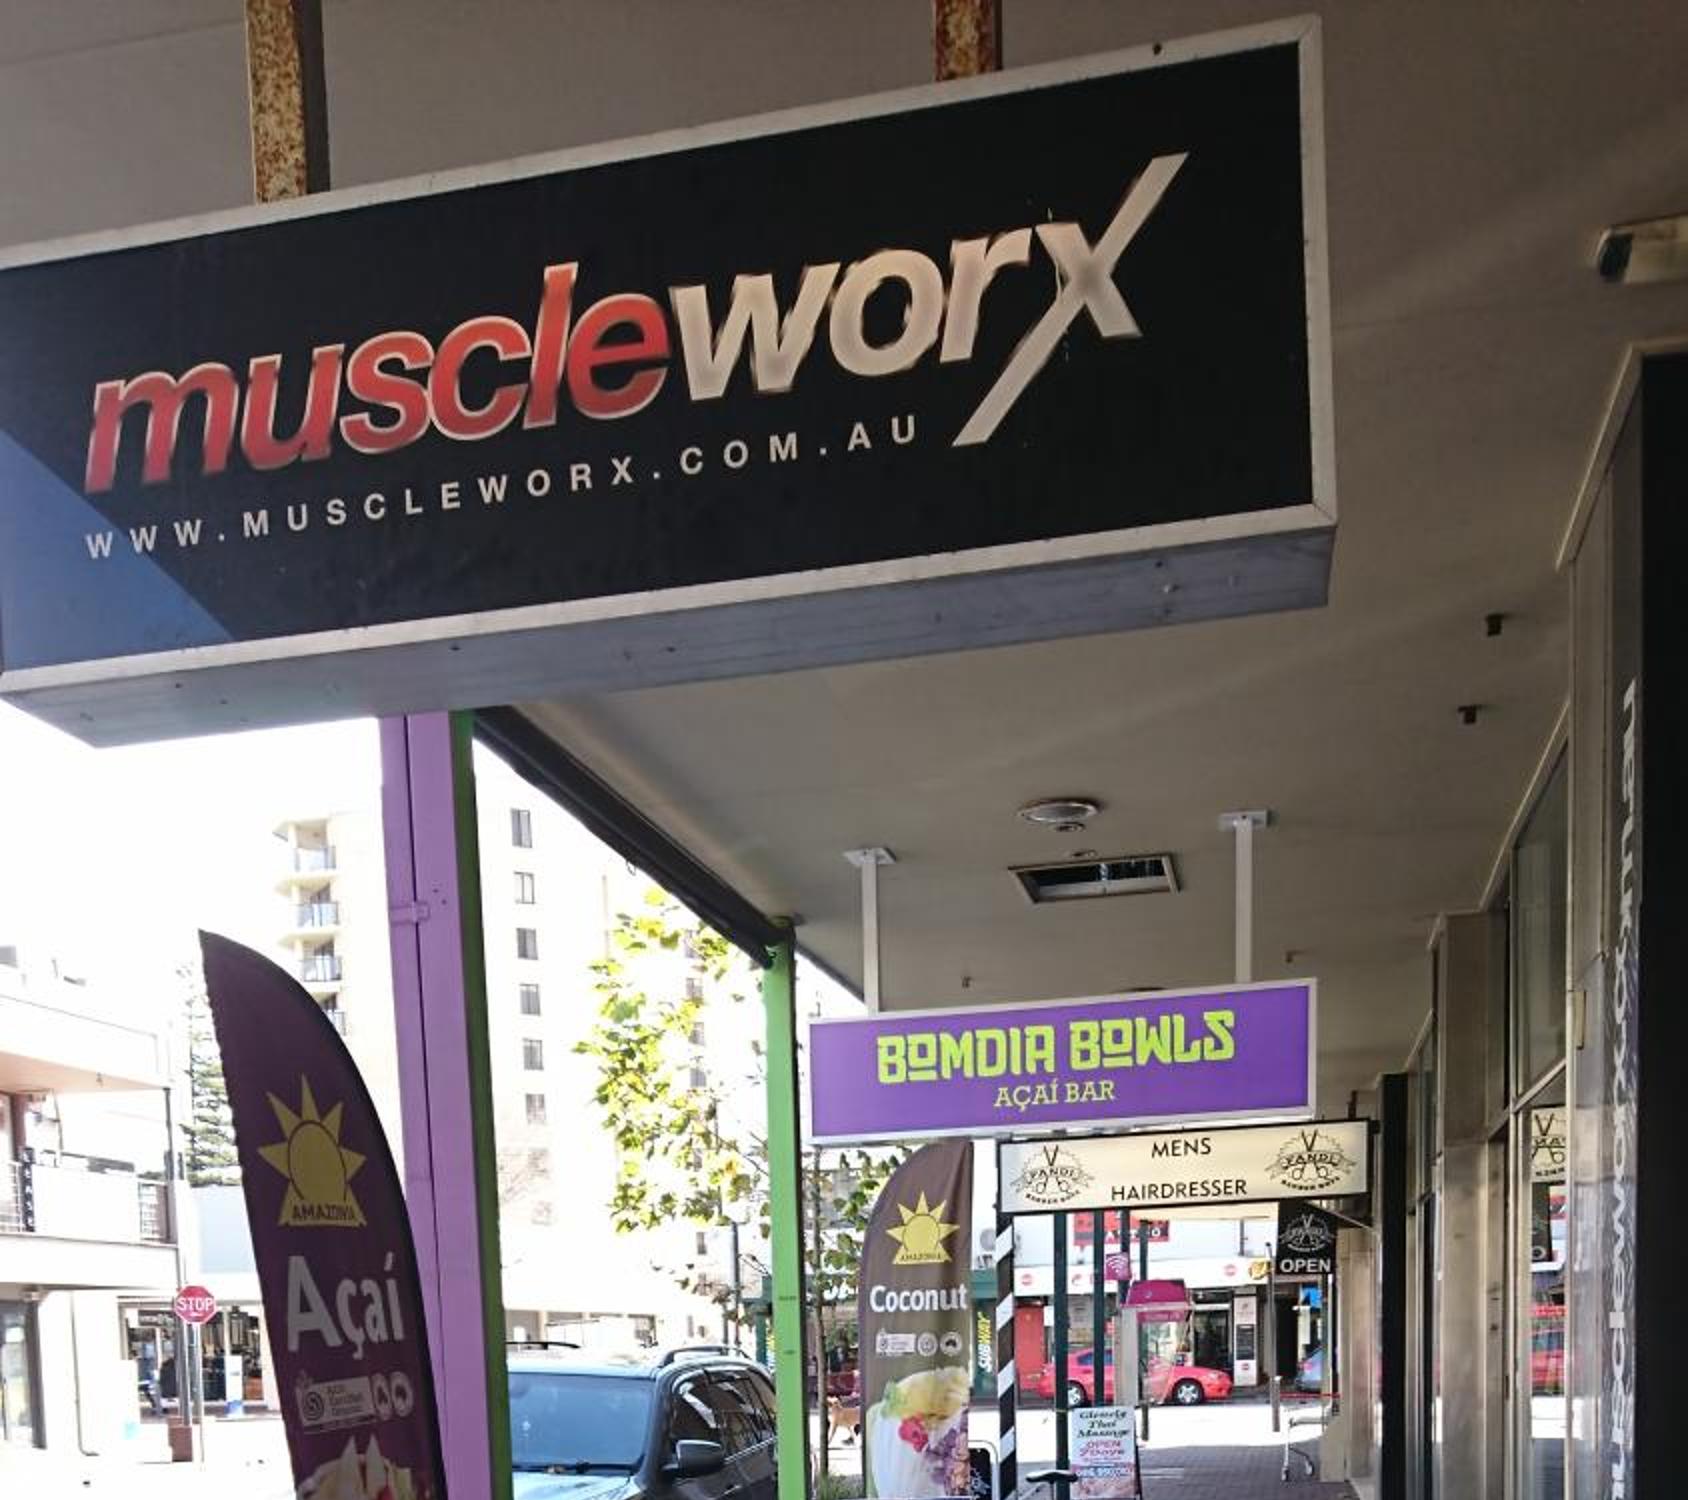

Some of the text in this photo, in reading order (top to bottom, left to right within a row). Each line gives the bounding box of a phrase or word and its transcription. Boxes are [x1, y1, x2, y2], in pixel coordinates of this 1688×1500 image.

[85, 151, 1190, 493] muscleworx
[85, 415, 917, 560] WWW.MUSCLEWORX.COM.AU
[876, 1010, 1235, 1085] BOMDIA BOWLS
[993, 1078, 1116, 1111] AÇAÍ BAR
[1151, 1137, 1212, 1159] MENS
[1111, 1179, 1248, 1201] HAIRDRESSER
[1279, 1258, 1332, 1273] OPEN
[176, 1297, 216, 1312] STOP
[287, 1251, 404, 1360] Açaí
[869, 1283, 968, 1313] Coconut
[977, 1311, 993, 1373] SUBWAY
